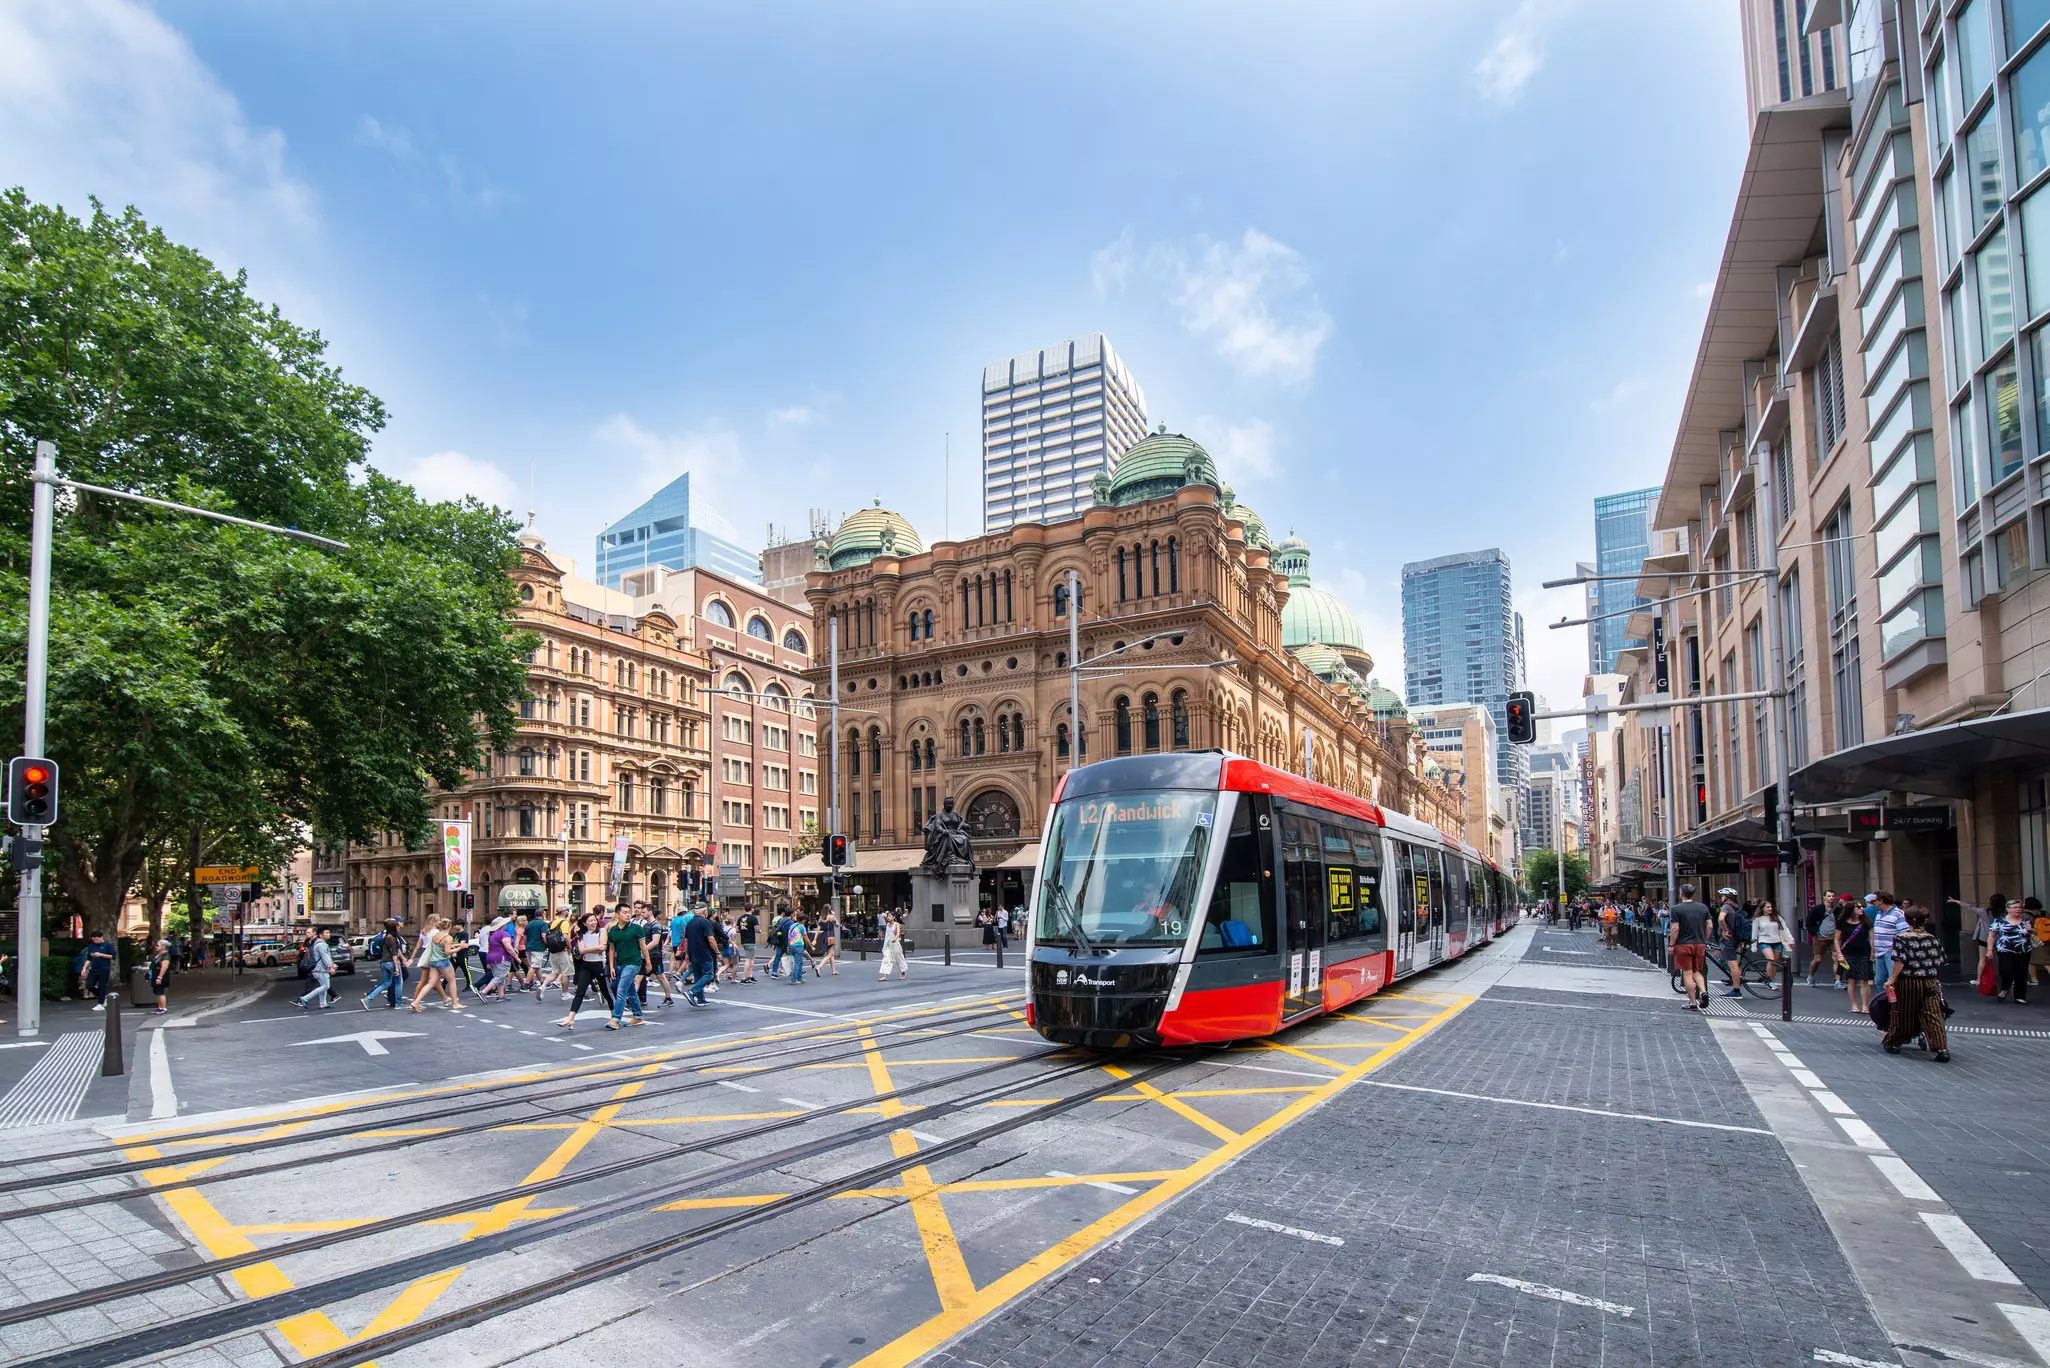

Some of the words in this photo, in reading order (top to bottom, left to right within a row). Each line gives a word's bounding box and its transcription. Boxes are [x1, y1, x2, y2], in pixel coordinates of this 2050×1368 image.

[1586, 762, 1595, 820] GOWINGS
[1079, 805, 1098, 825] L2
[1106, 801, 1182, 823] Randwick
[1913, 817, 1943, 825] Banking
[505, 890, 541, 900] OPALS
[1161, 920, 1182, 936] 19
[1087, 979, 1116, 987] Transport
